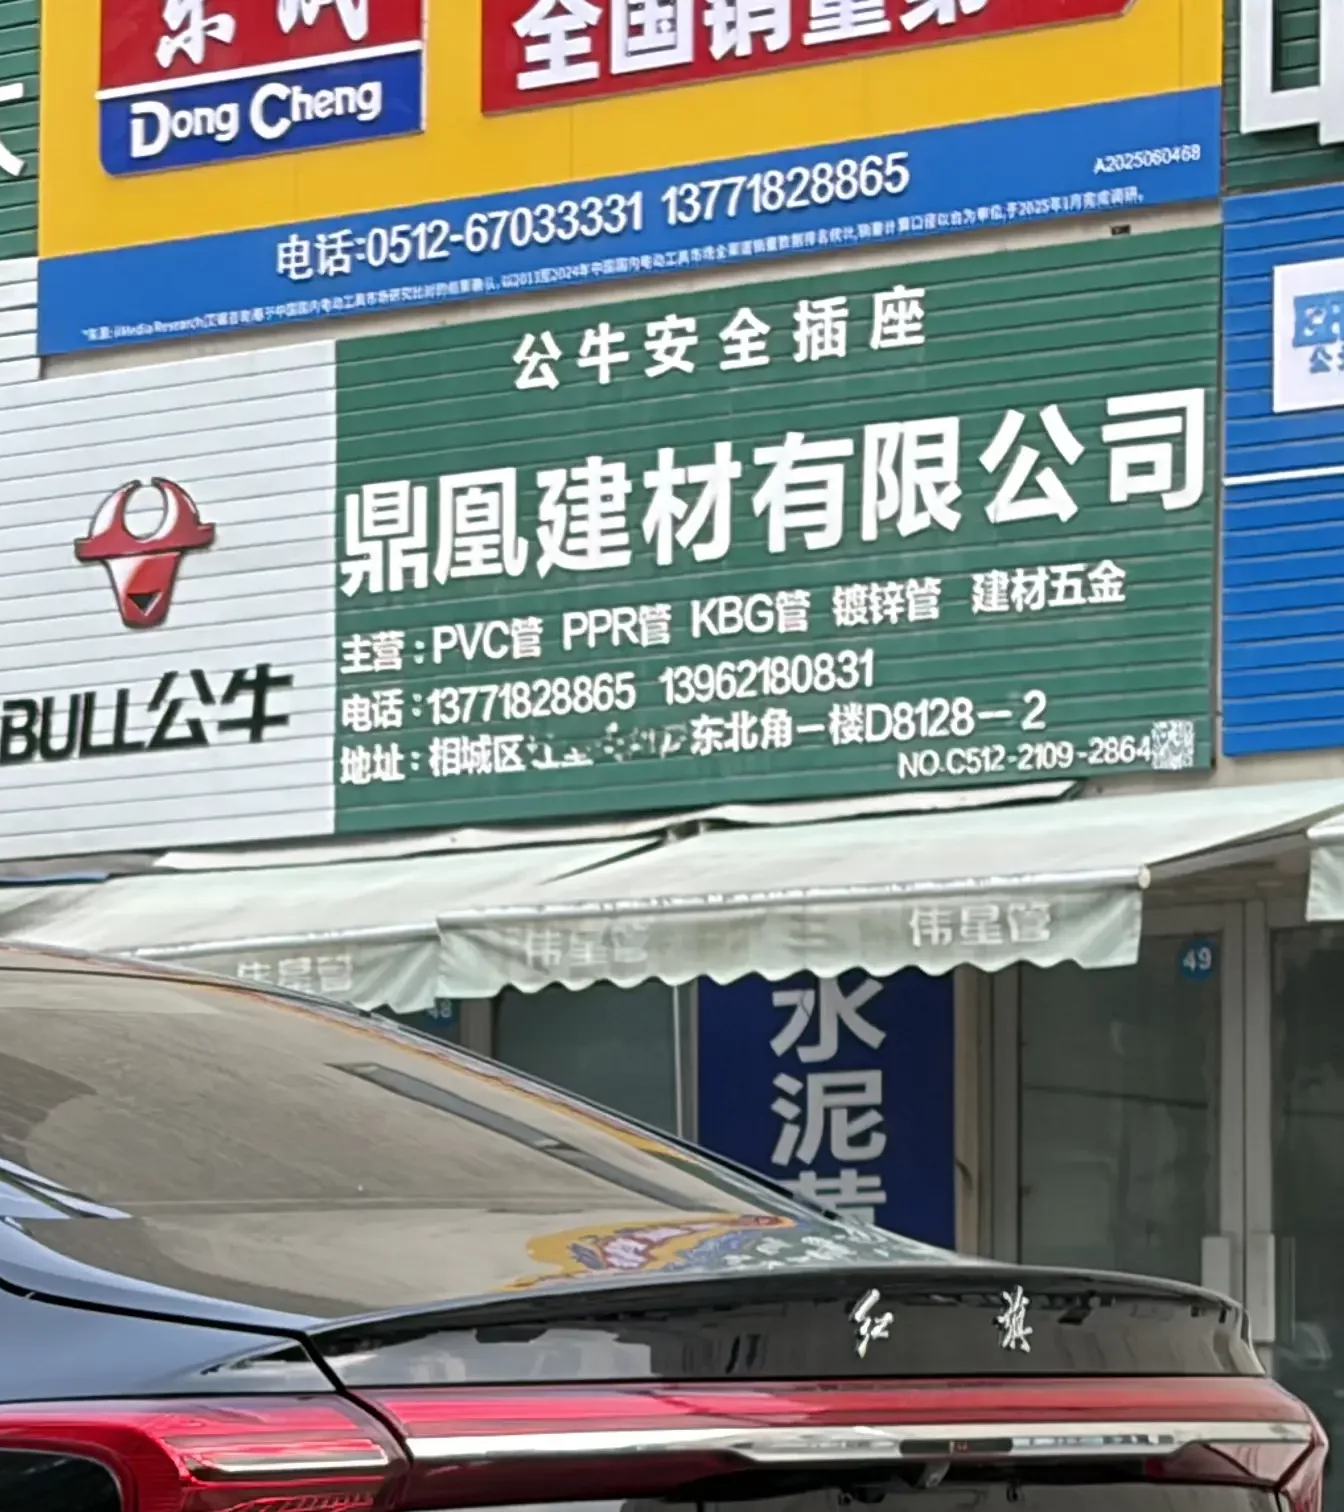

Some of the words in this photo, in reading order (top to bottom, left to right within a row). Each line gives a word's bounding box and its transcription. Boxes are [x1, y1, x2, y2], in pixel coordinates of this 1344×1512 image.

[250, 82, 383, 140] Cheng
[660, 152, 910, 228] 13771828865
[512, 284, 928, 391] 公牛安全插座
[339, 387, 1205, 599] 鼎凰建材有限公司
[562, 603, 671, 650] PPR管
[691, 589, 811, 638] KBG管
[831, 577, 942, 628] 镀锌管
[969, 558, 1127, 615] 建材五金
[658, 647, 875, 705] 13962180831
[1182, 947, 1212, 972] 49
